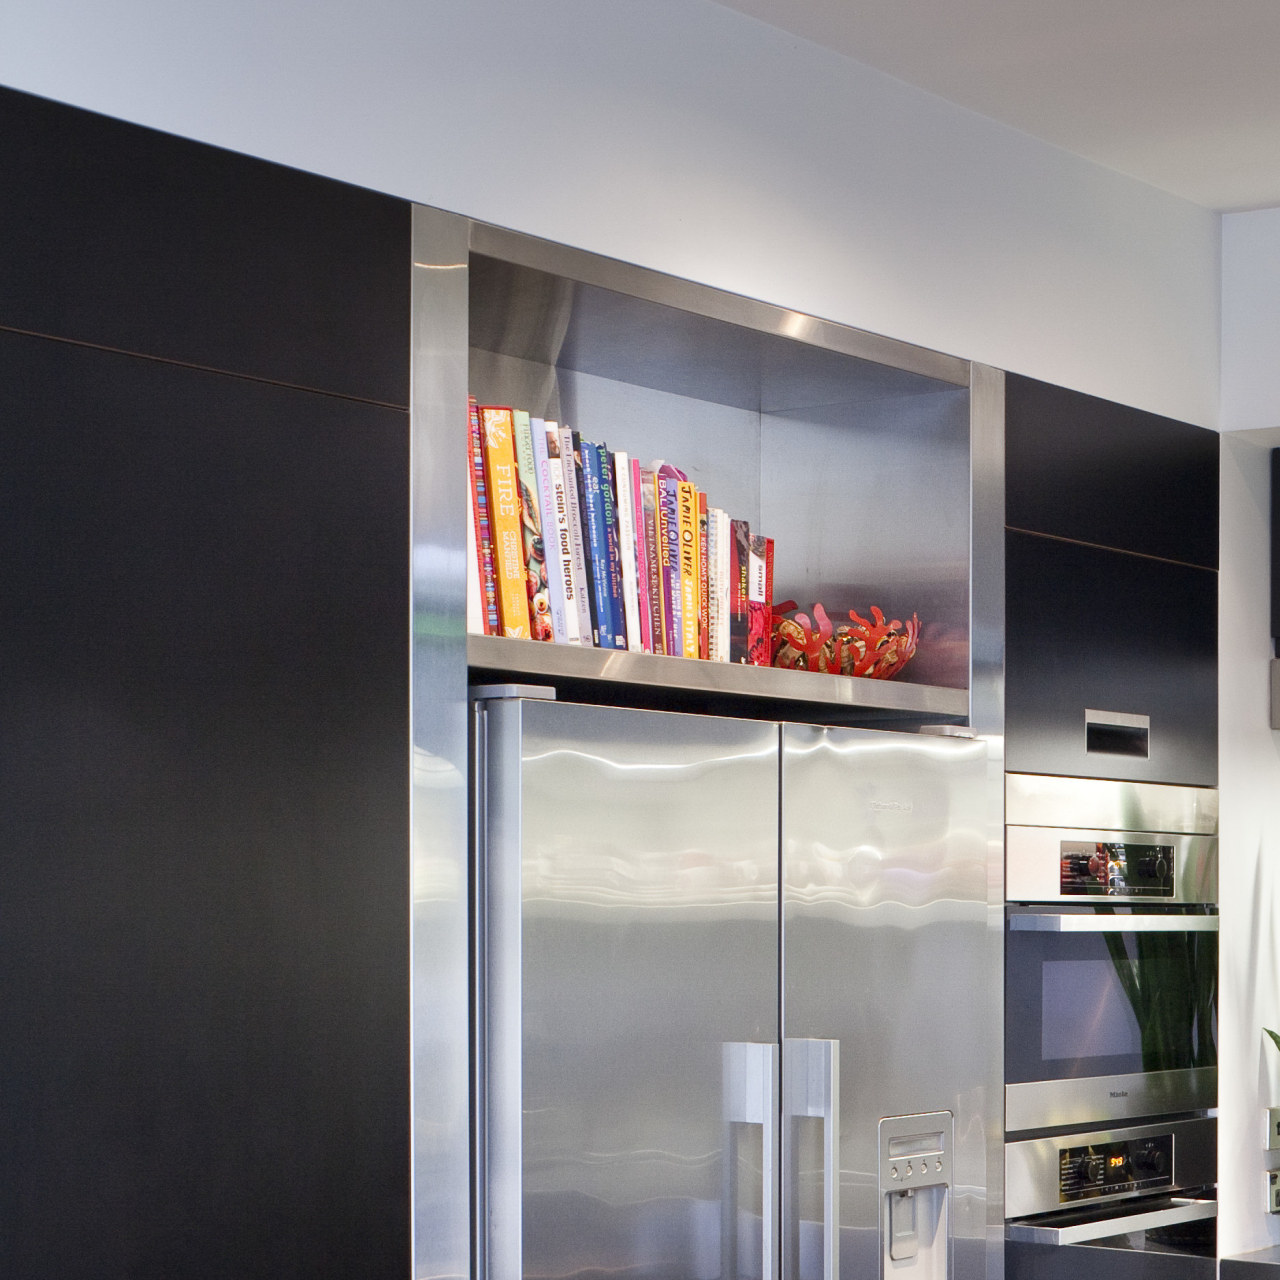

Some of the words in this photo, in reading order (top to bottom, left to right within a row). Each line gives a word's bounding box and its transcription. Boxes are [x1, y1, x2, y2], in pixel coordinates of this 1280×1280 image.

[566, 454, 577, 500] Enchanted
[598, 449, 609, 480] peter
[497, 464, 514, 516] FIRE
[541, 460, 552, 518] COCKTAIL
[547, 522, 555, 550] BOOK
[555, 484, 566, 524] stein's
[601, 484, 614, 525] gordon
[666, 490, 678, 527] JAMIE
[681, 485, 692, 528] JAMIE
[560, 528, 570, 555] food
[570, 502, 580, 540] Broccoli
[502, 531, 513, 579] MANFIELD
[510, 531, 520, 579] CHRISTINE
[610, 562, 616, 572] my
[649, 520, 659, 586] VIETNAMESE
[682, 530, 693, 576] OLIVER
[563, 559, 574, 600] heroes
[652, 588, 661, 635] KITCHEN
[685, 621, 694, 652] ITALY
